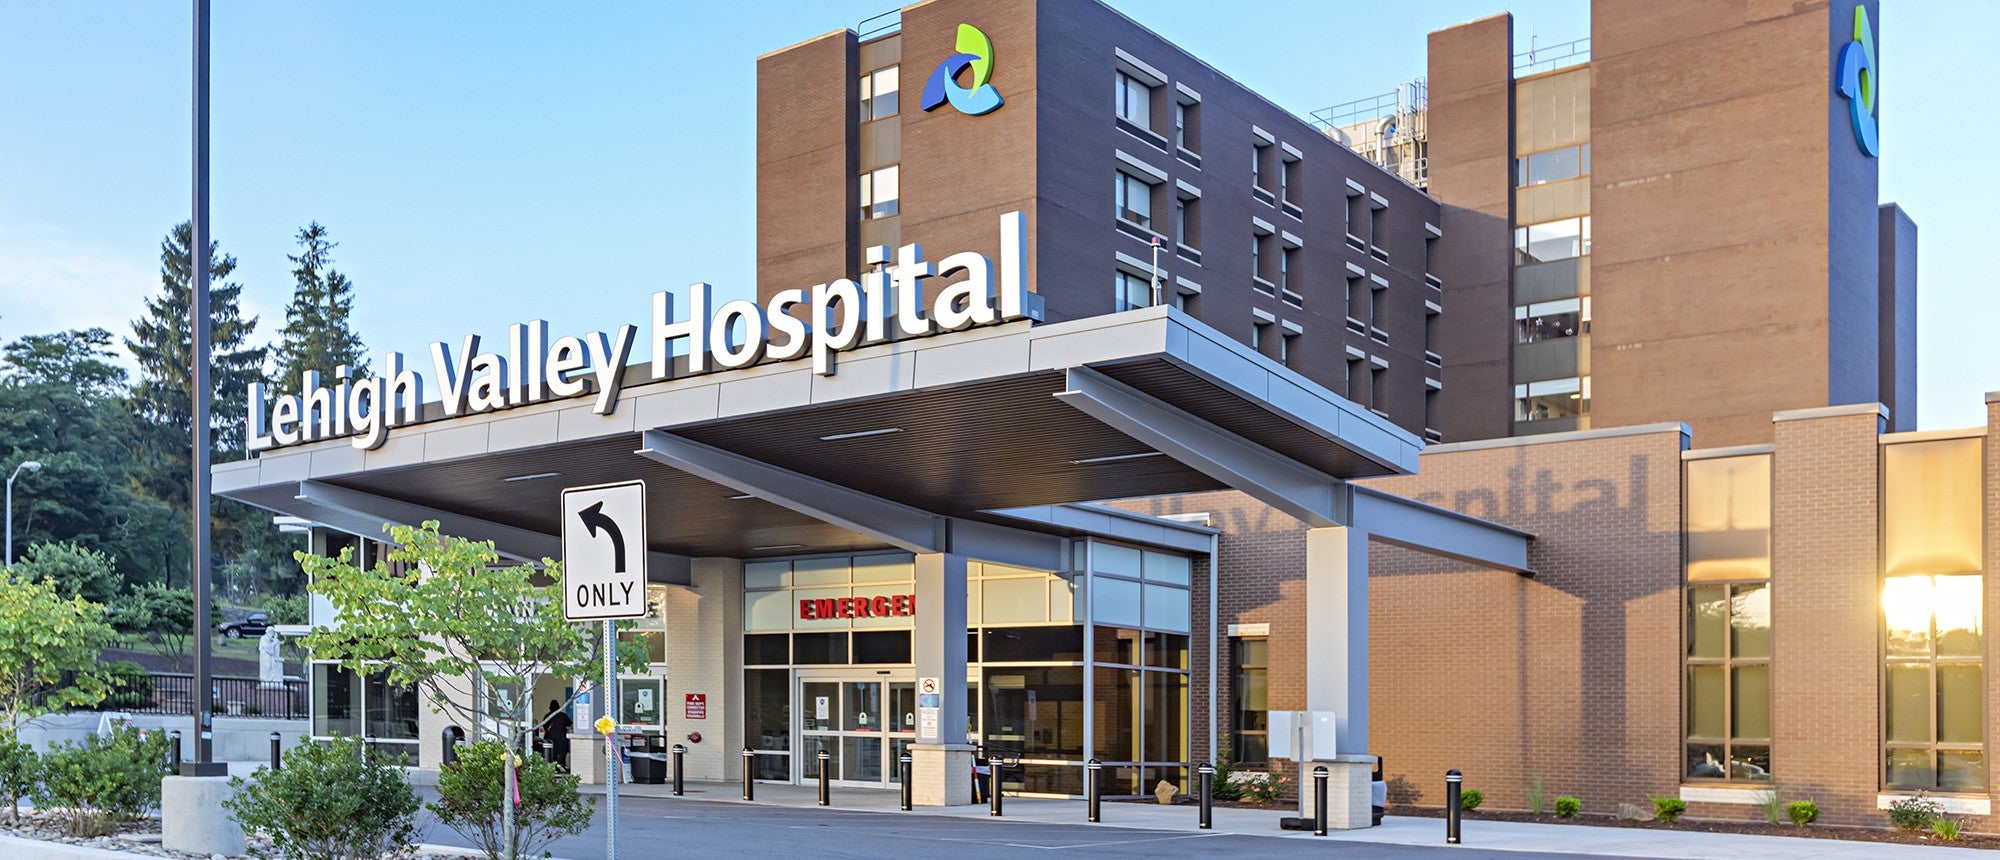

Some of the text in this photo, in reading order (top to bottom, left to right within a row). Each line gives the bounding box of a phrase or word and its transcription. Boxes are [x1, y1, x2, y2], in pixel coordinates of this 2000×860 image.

[247, 210, 1027, 450] Lehigh Valley Hospital
[577, 581, 634, 607] ONLY
